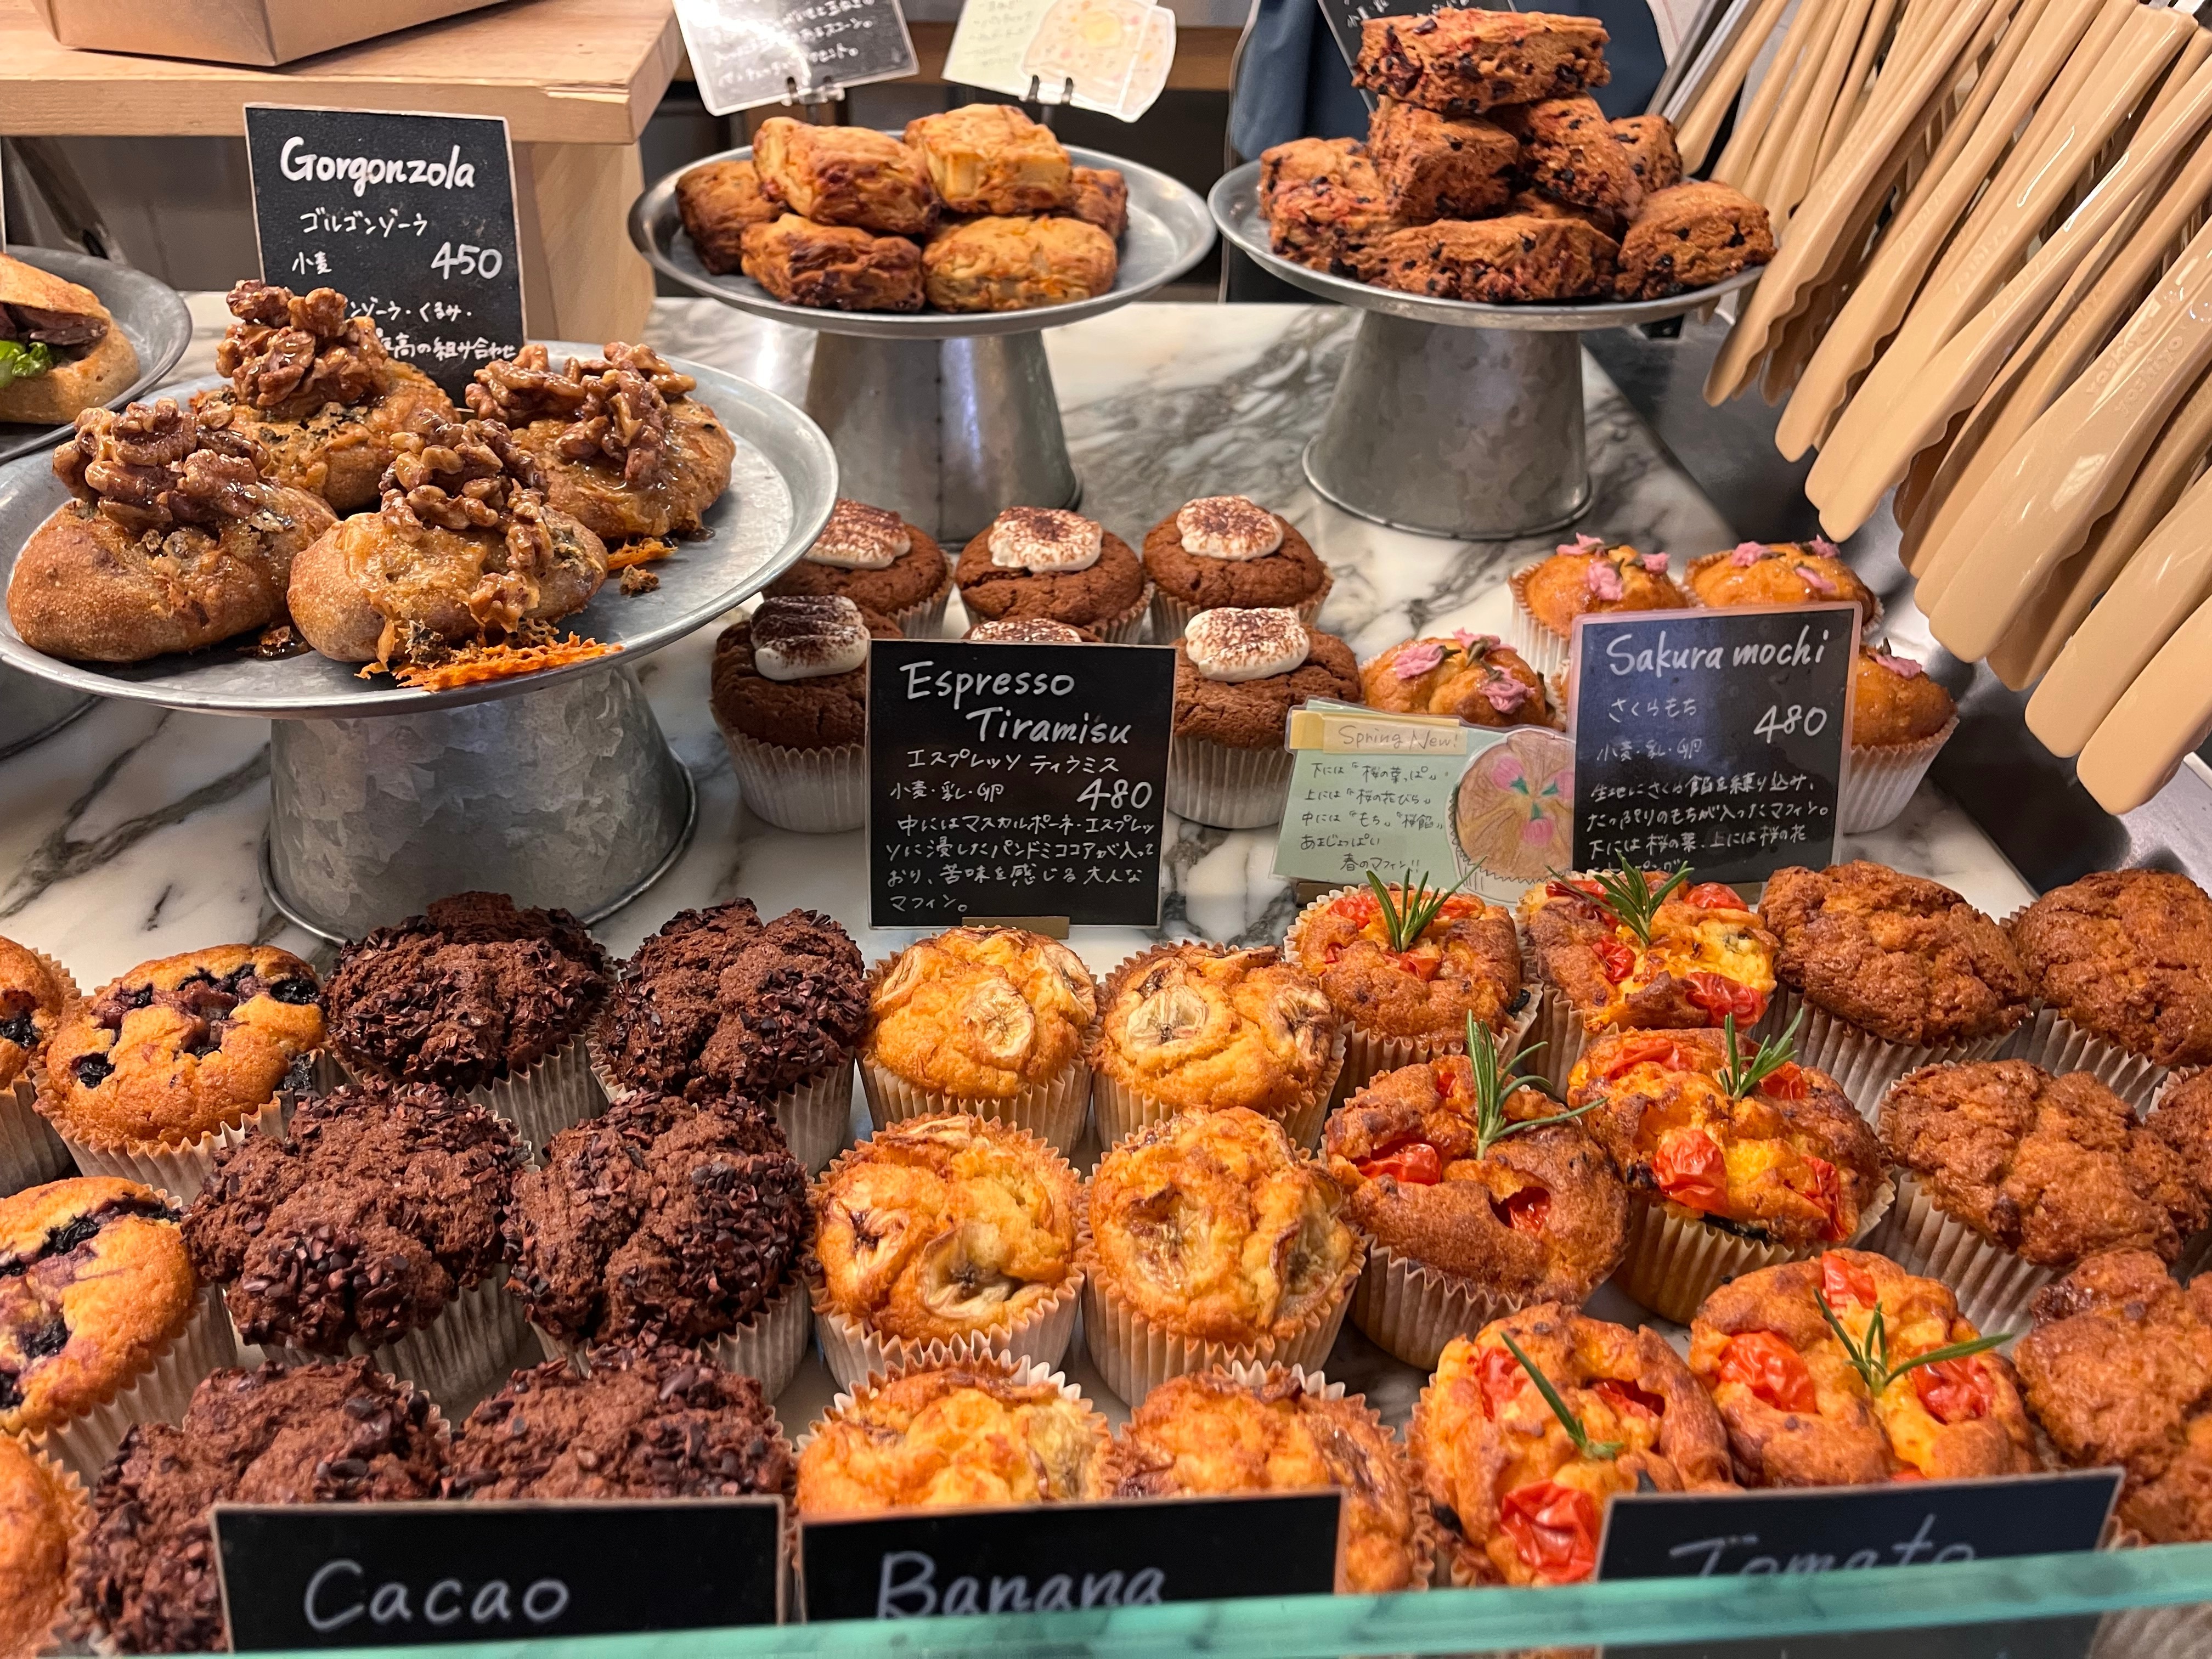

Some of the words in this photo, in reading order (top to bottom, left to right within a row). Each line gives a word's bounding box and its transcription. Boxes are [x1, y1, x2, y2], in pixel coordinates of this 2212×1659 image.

[280, 137, 476, 198] Gorgonzola
[291, 250, 332, 275] 小麦
[431, 241, 504, 280] 450
[1606, 630, 1724, 679] Sakura
[1732, 624, 1829, 667] mochi
[899, 661, 1075, 710] Espresso
[966, 706, 1132, 744] Tiramisu
[1608, 697, 1698, 724] さくらもち
[1753, 704, 1828, 744] 480
[1338, 725, 1403, 749] Spring
[1408, 729, 1459, 749] New!
[1076, 777, 1153, 811] 480
[887, 863, 1143, 888] おり、苦味を感じる大人な
[889, 894, 968, 912] マフィン。
[304, 1558, 569, 1632] Cacao
[877, 1550, 1166, 1620] Banana
